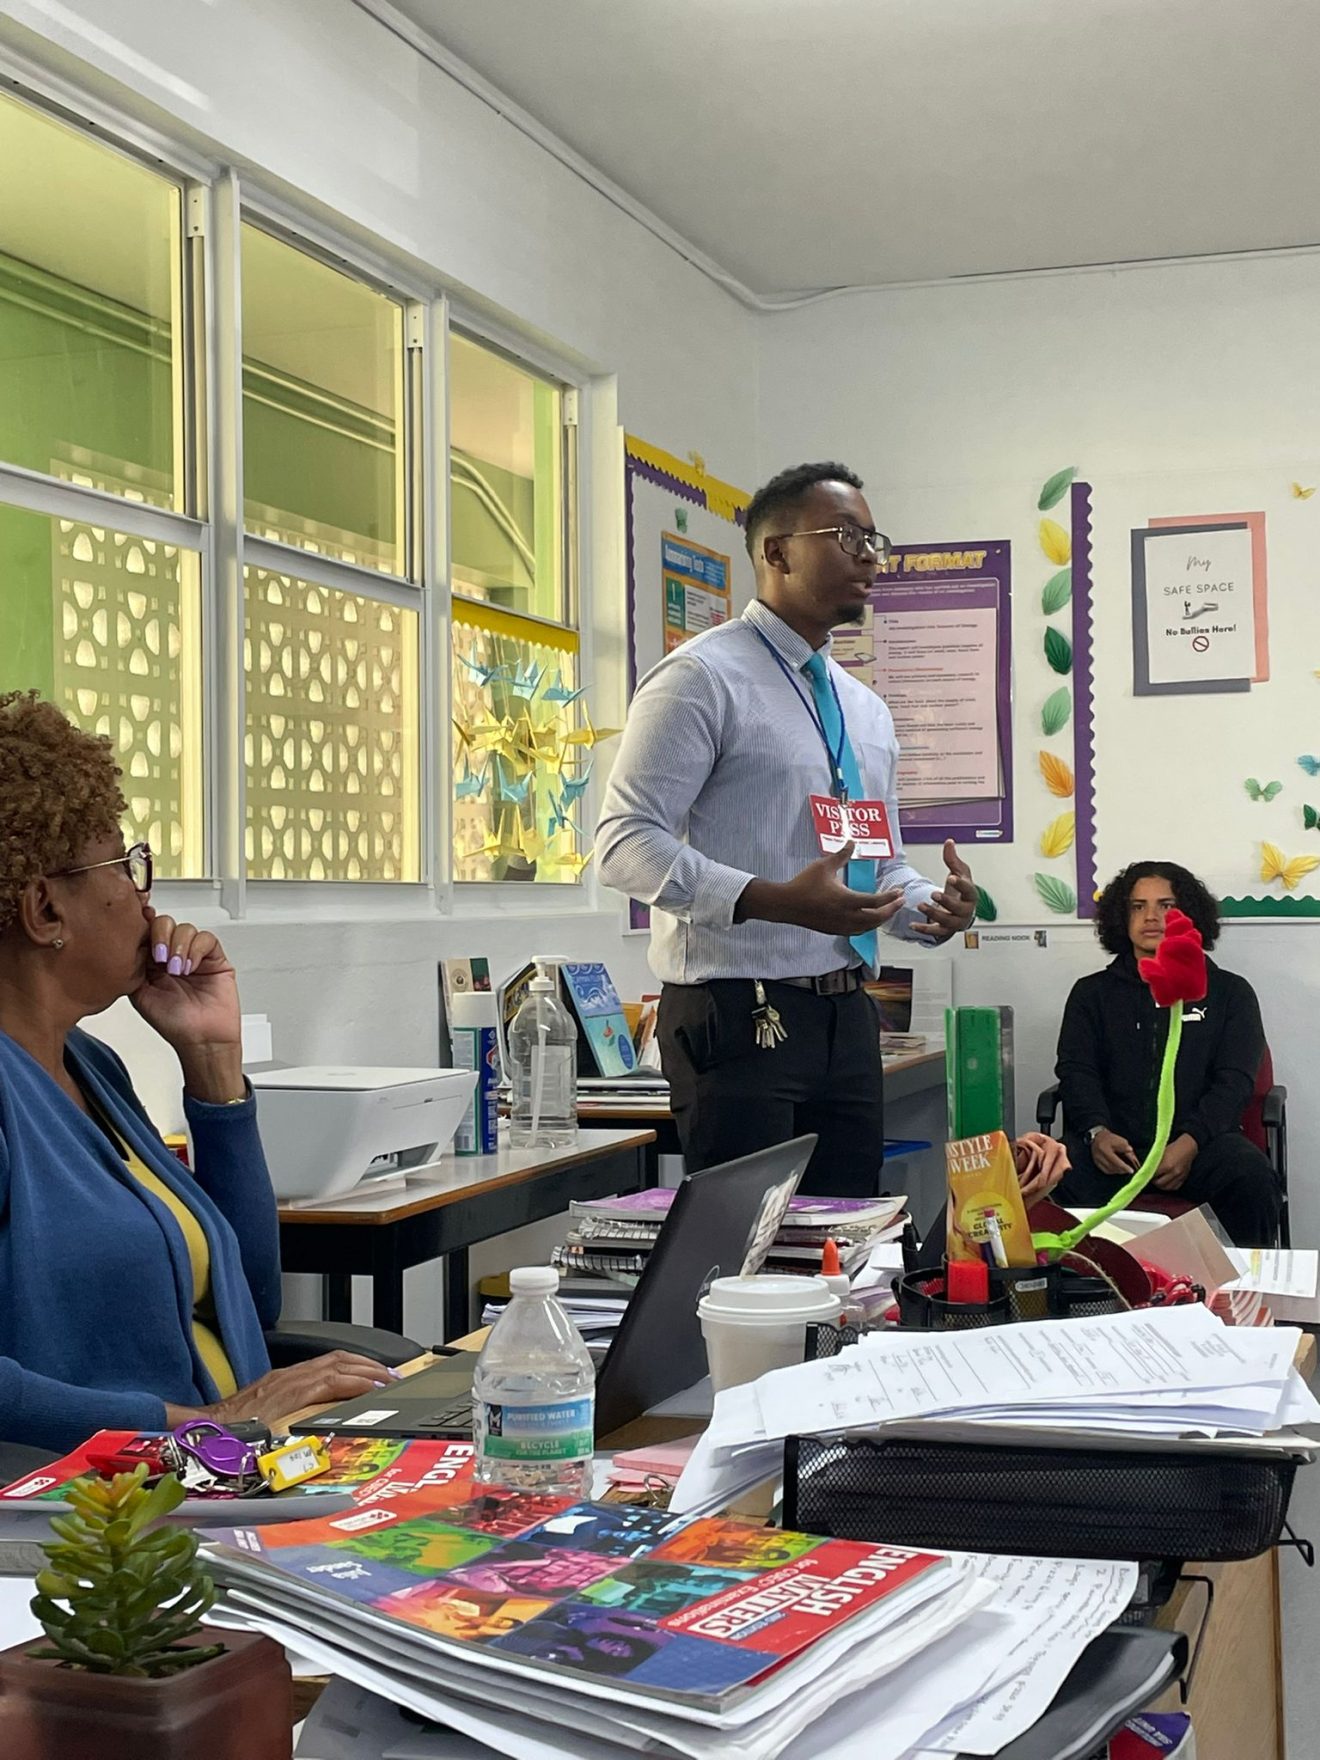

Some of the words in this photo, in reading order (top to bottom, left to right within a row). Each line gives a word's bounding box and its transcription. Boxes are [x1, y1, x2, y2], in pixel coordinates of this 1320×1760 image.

[904, 550, 987, 573] FORMAT
[1186, 555, 1211, 571] My
[1163, 585, 1192, 596] SAFE
[1196, 582, 1234, 593] SPACE
[1166, 628, 1178, 636] No
[1212, 624, 1236, 633] Here!
[815, 803, 881, 822] VISTOR
[830, 820, 870, 837] PSS
[950, 1152, 991, 1174] WEEK
[507, 1413, 545, 1422] PURIFIED
[547, 1409, 575, 1420] WATER
[520, 1440, 559, 1449] RECYCLE
[798, 1558, 818, 1571] for
[792, 1546, 921, 1616] ENGLISH
[668, 1585, 758, 1627] Examinations
[698, 1575, 830, 1636] MATTERS
